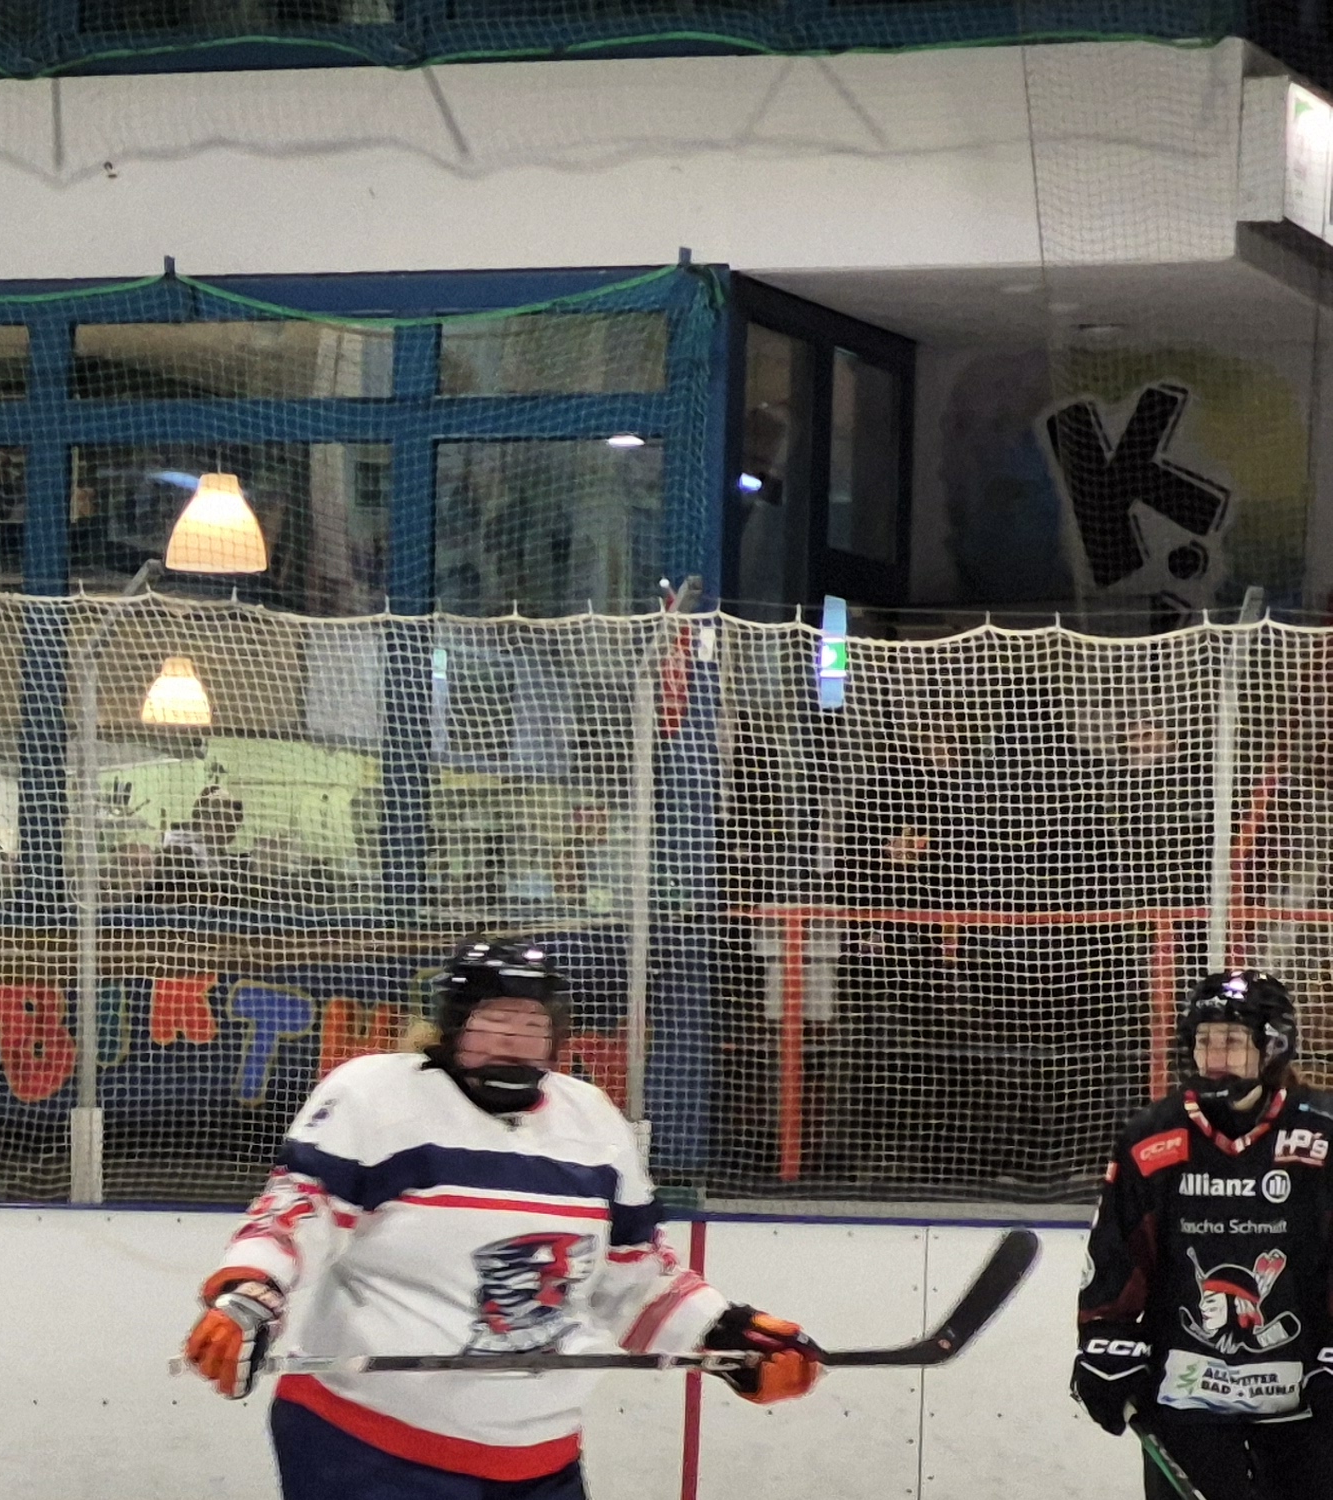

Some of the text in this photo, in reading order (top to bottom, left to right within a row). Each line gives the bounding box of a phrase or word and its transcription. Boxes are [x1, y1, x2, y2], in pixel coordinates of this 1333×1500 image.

[1140, 1137, 1182, 1161] CCM
[1179, 1172, 1256, 1197] Allianz
[1087, 1338, 1152, 1357] CCM
